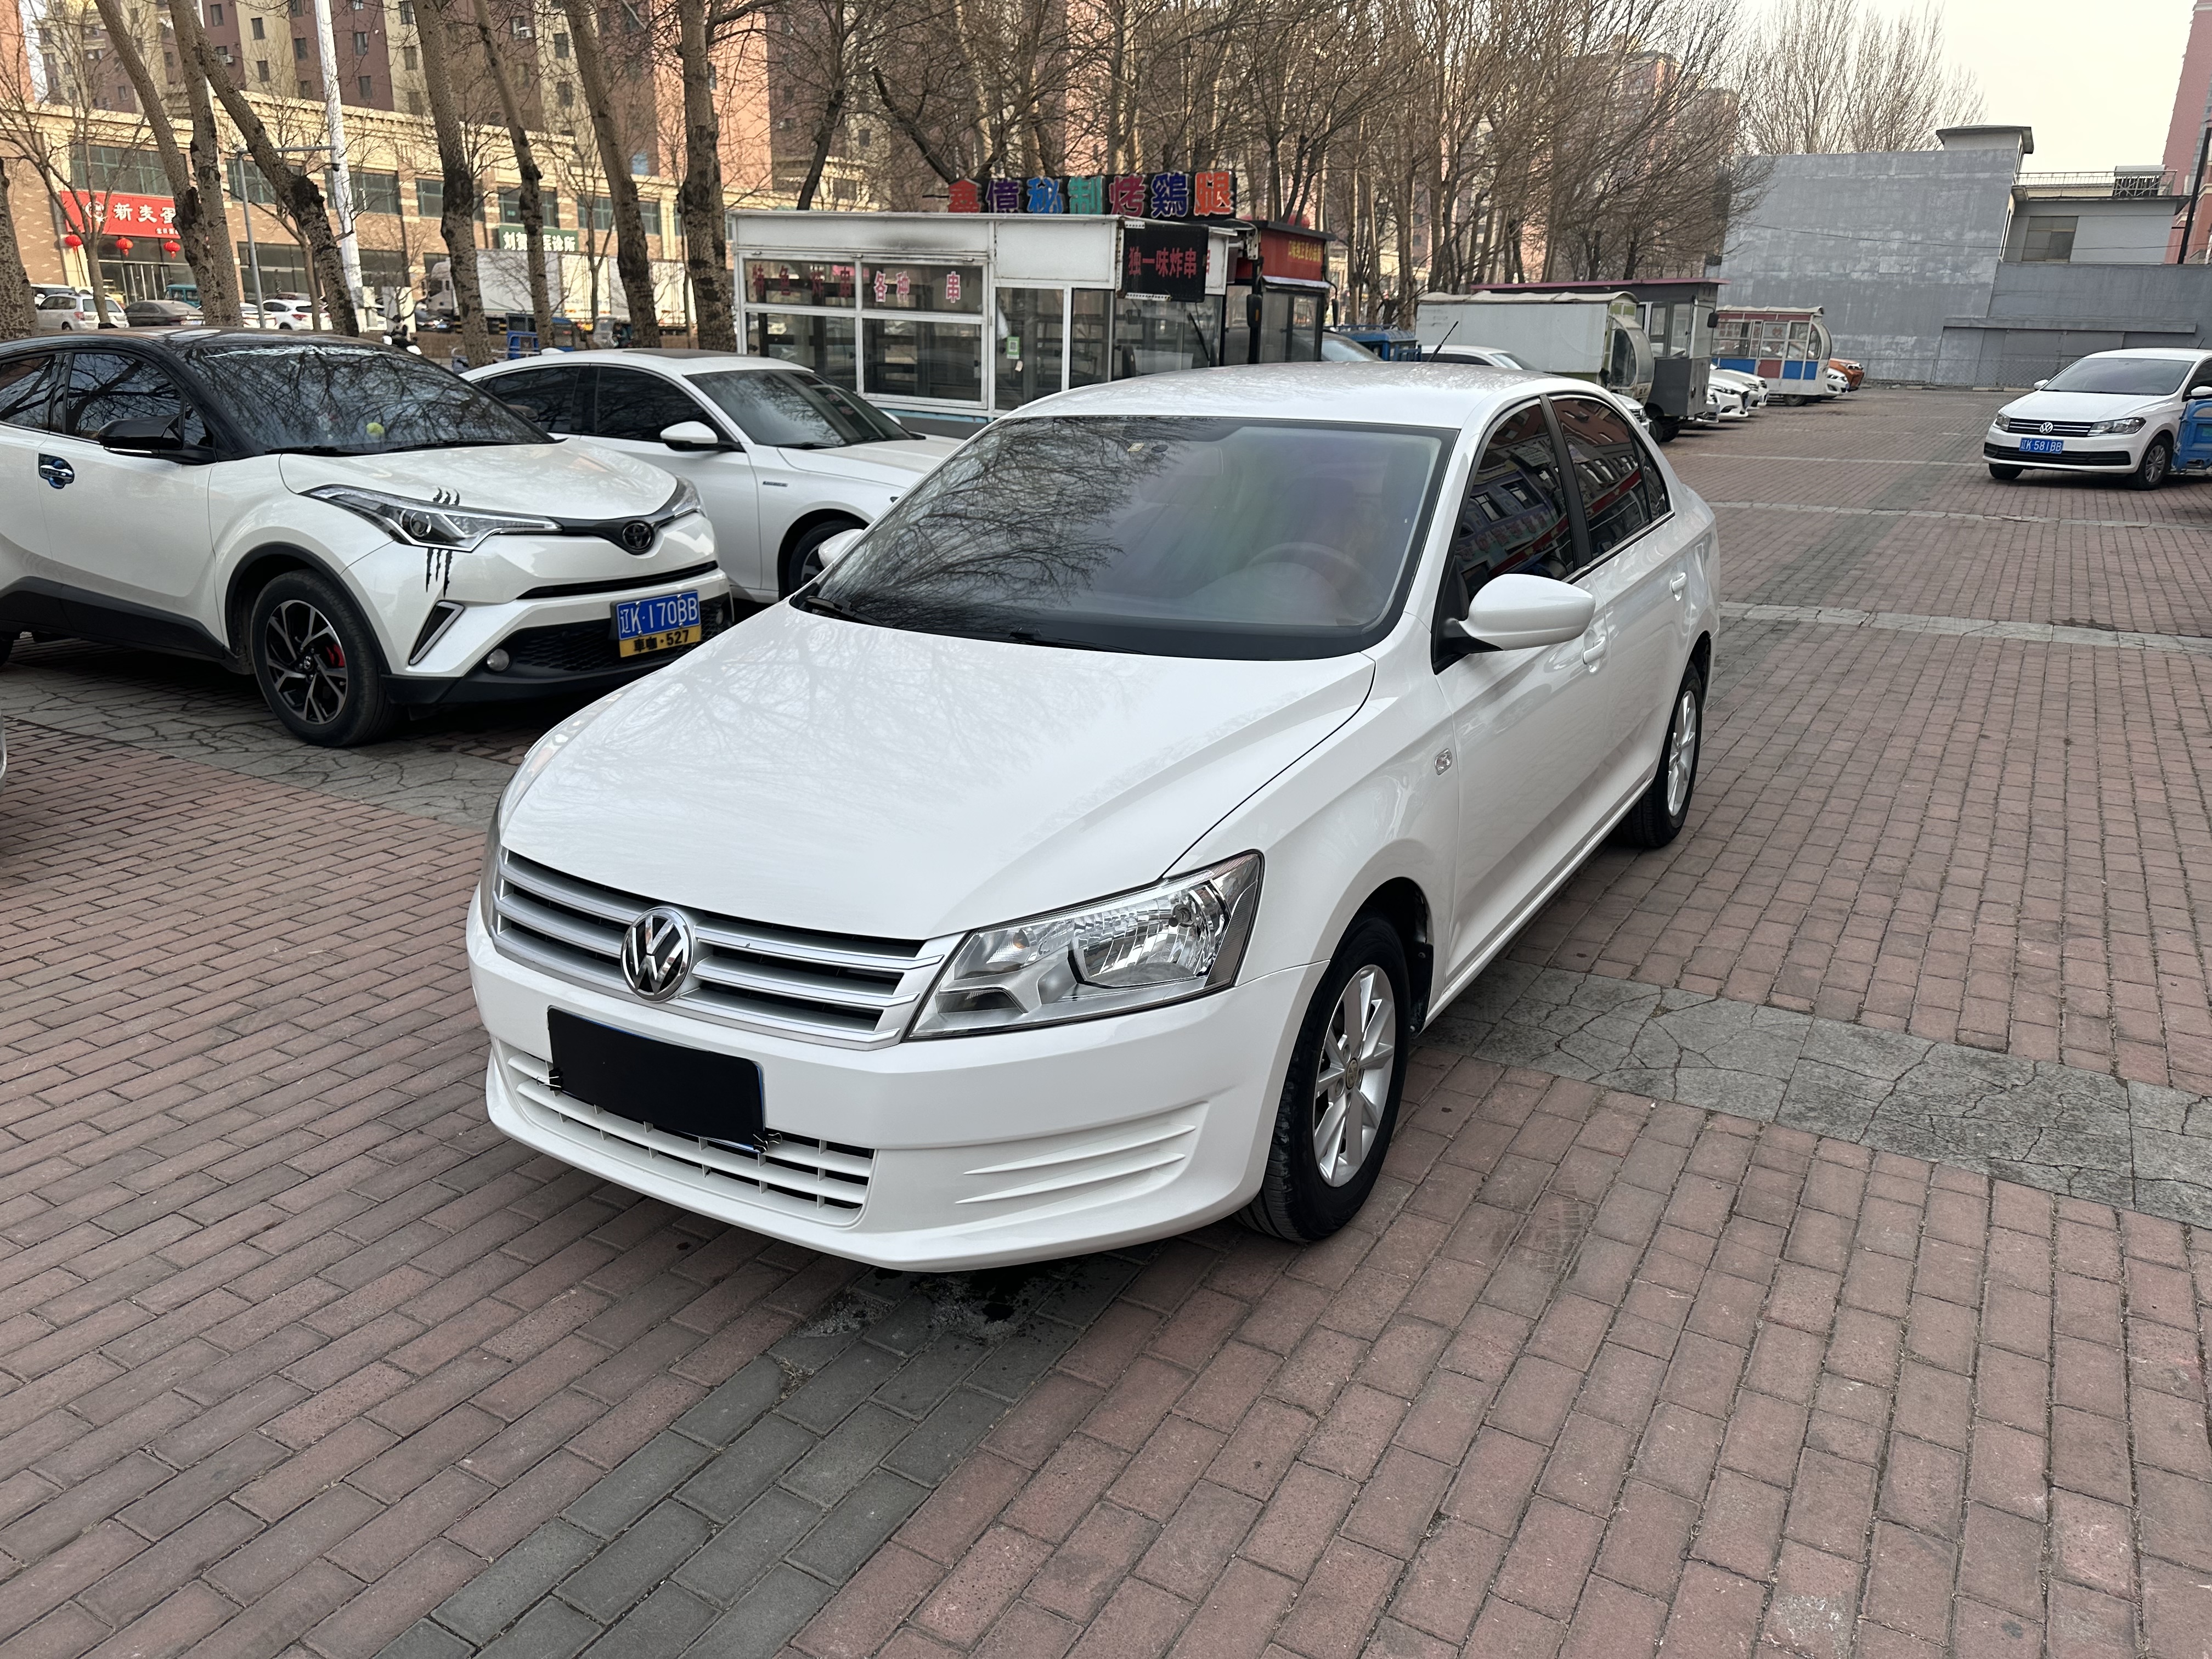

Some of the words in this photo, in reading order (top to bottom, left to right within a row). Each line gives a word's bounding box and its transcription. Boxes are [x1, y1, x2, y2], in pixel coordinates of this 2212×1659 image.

[503, 231, 575, 251] 刘贺医诊所
[1128, 246, 1197, 279] 独一味炸串
